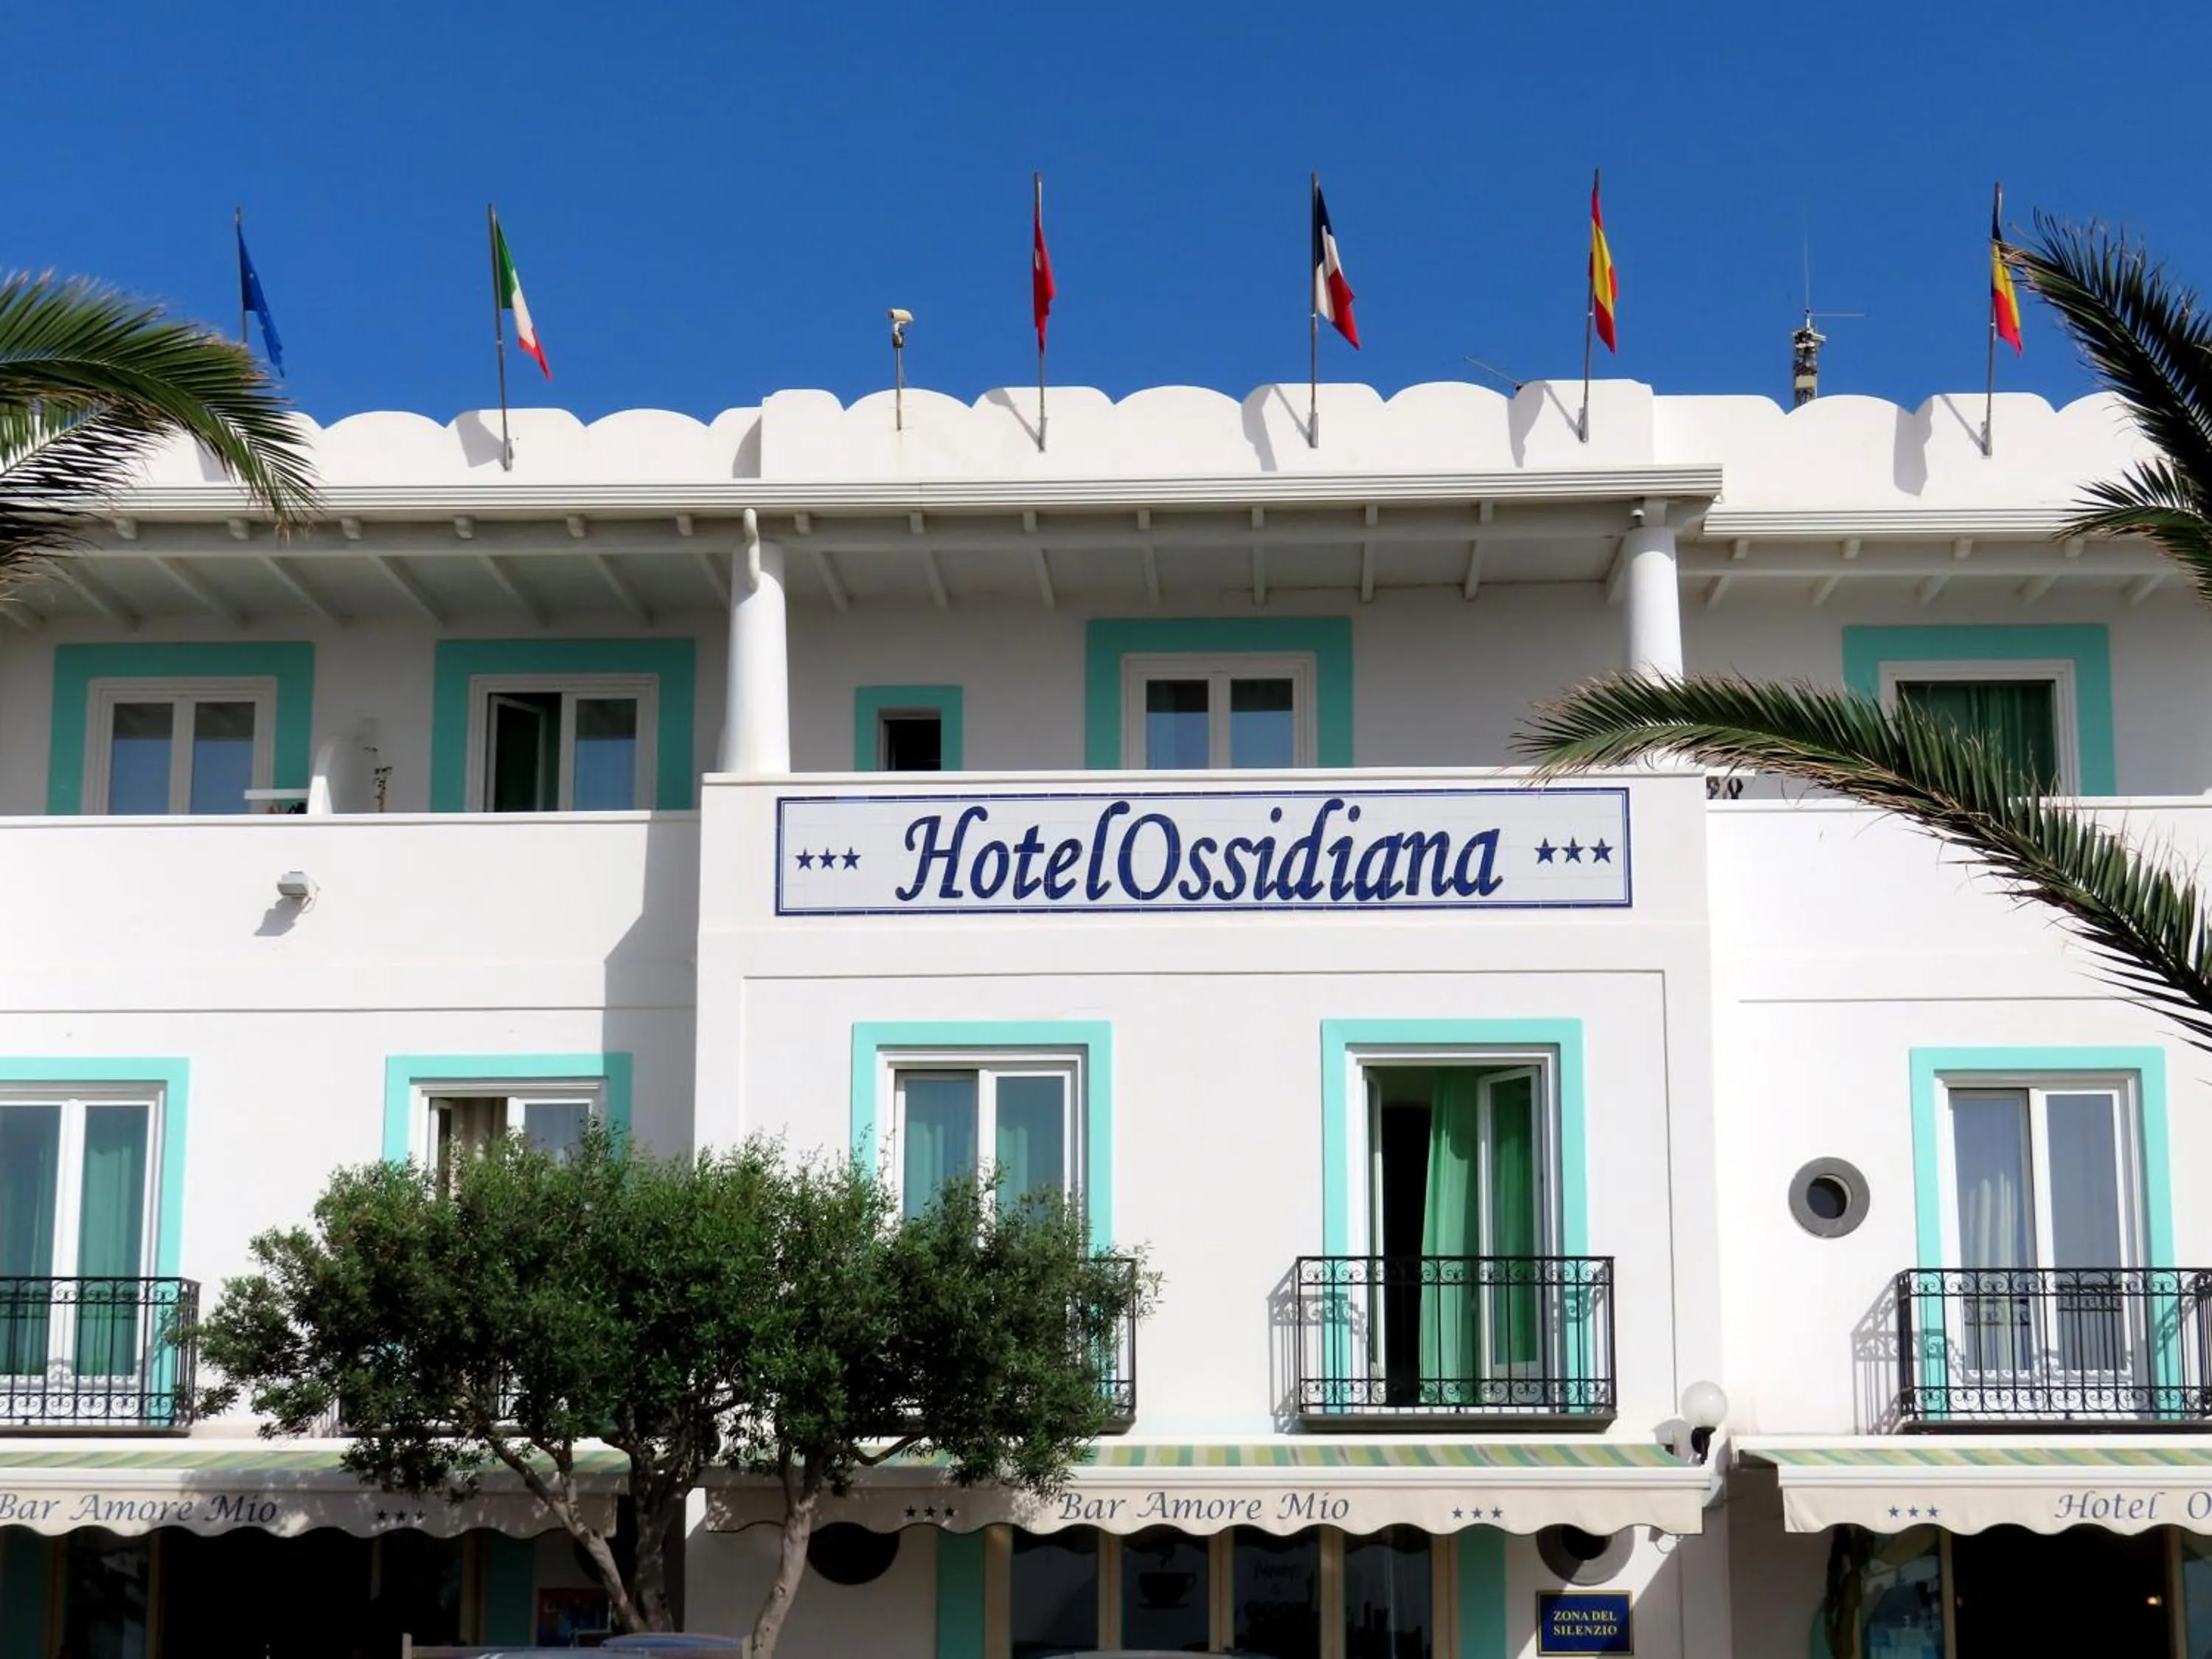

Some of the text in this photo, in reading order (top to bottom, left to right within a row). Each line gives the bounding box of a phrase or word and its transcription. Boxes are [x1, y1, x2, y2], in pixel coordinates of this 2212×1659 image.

[0, 1492, 276, 1523] Bar Amore Mio
[1058, 1491, 1349, 1520] Bar Amore Mio
[2054, 1490, 2166, 1520] Hotel
[1554, 1610, 1617, 1621] ZONA DEL
[1554, 1624, 1617, 1635] SILENZIO
